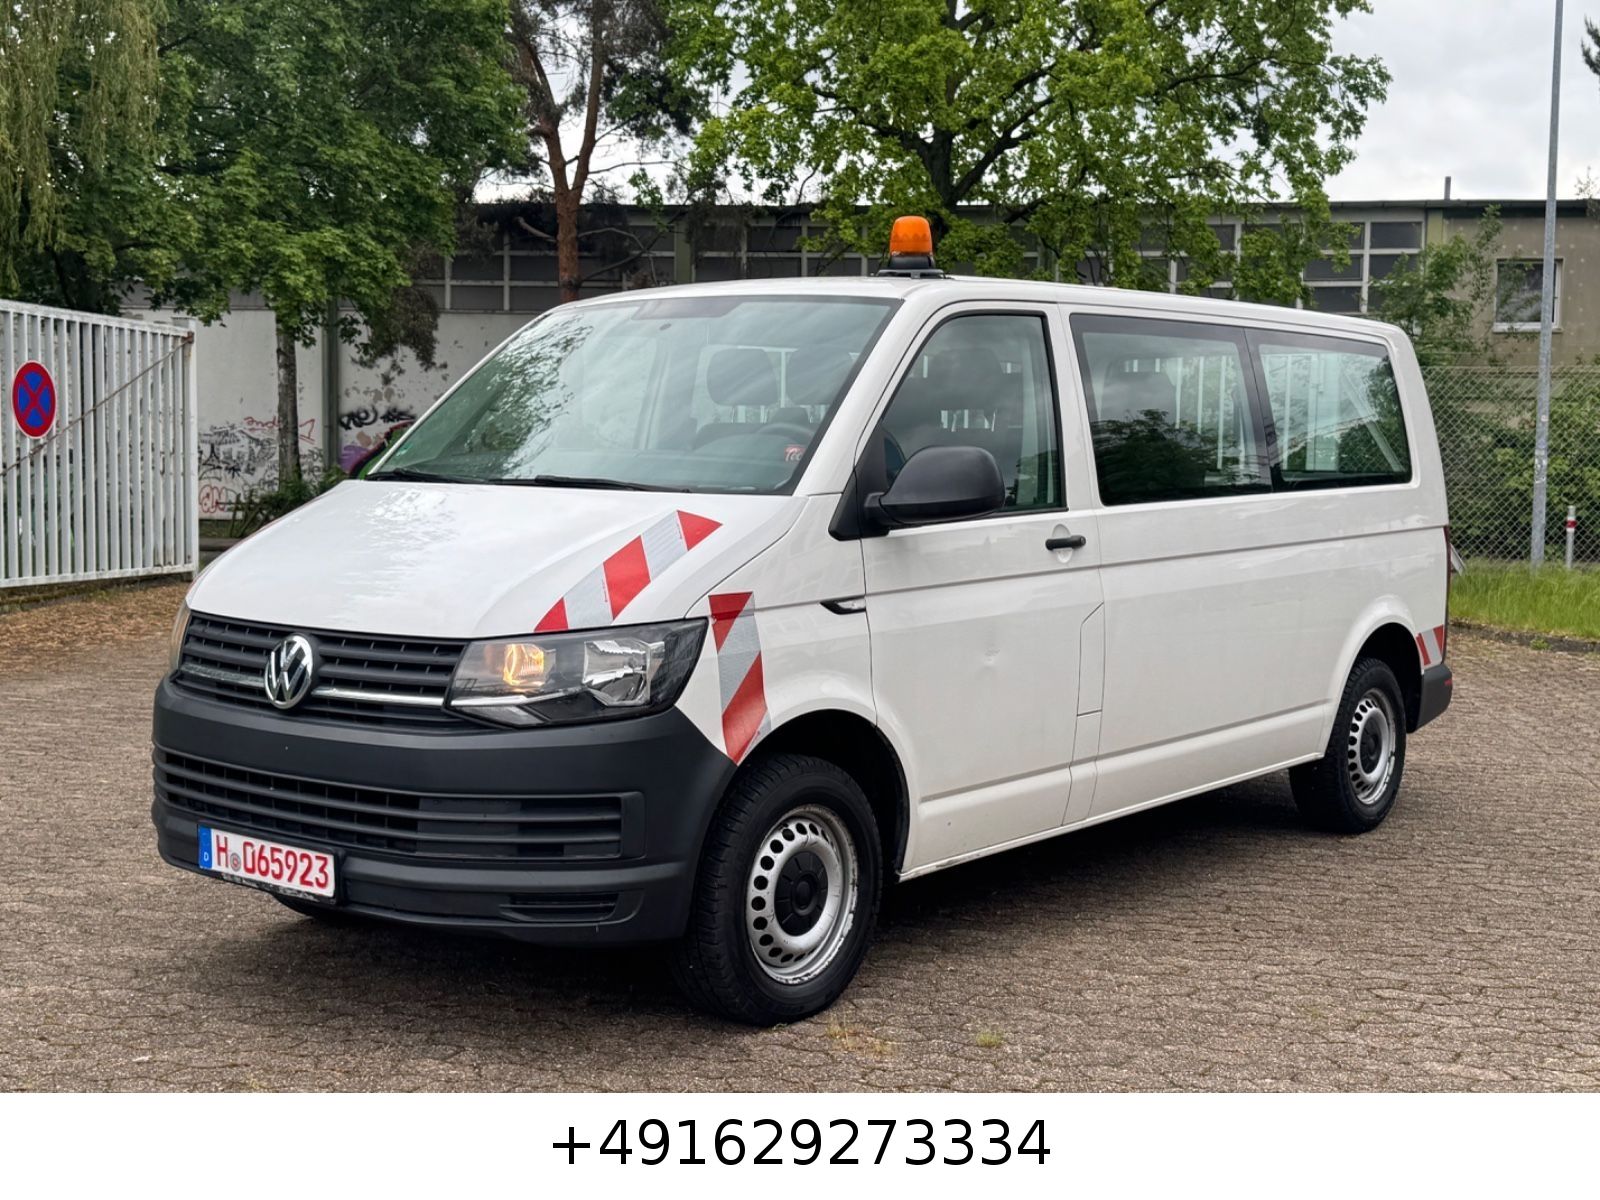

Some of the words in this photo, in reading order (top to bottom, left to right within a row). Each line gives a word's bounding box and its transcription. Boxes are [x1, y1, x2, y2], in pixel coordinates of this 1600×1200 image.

[203, 851, 210, 862] D
[215, 834, 229, 868] H
[242, 841, 329, 889] 065923
